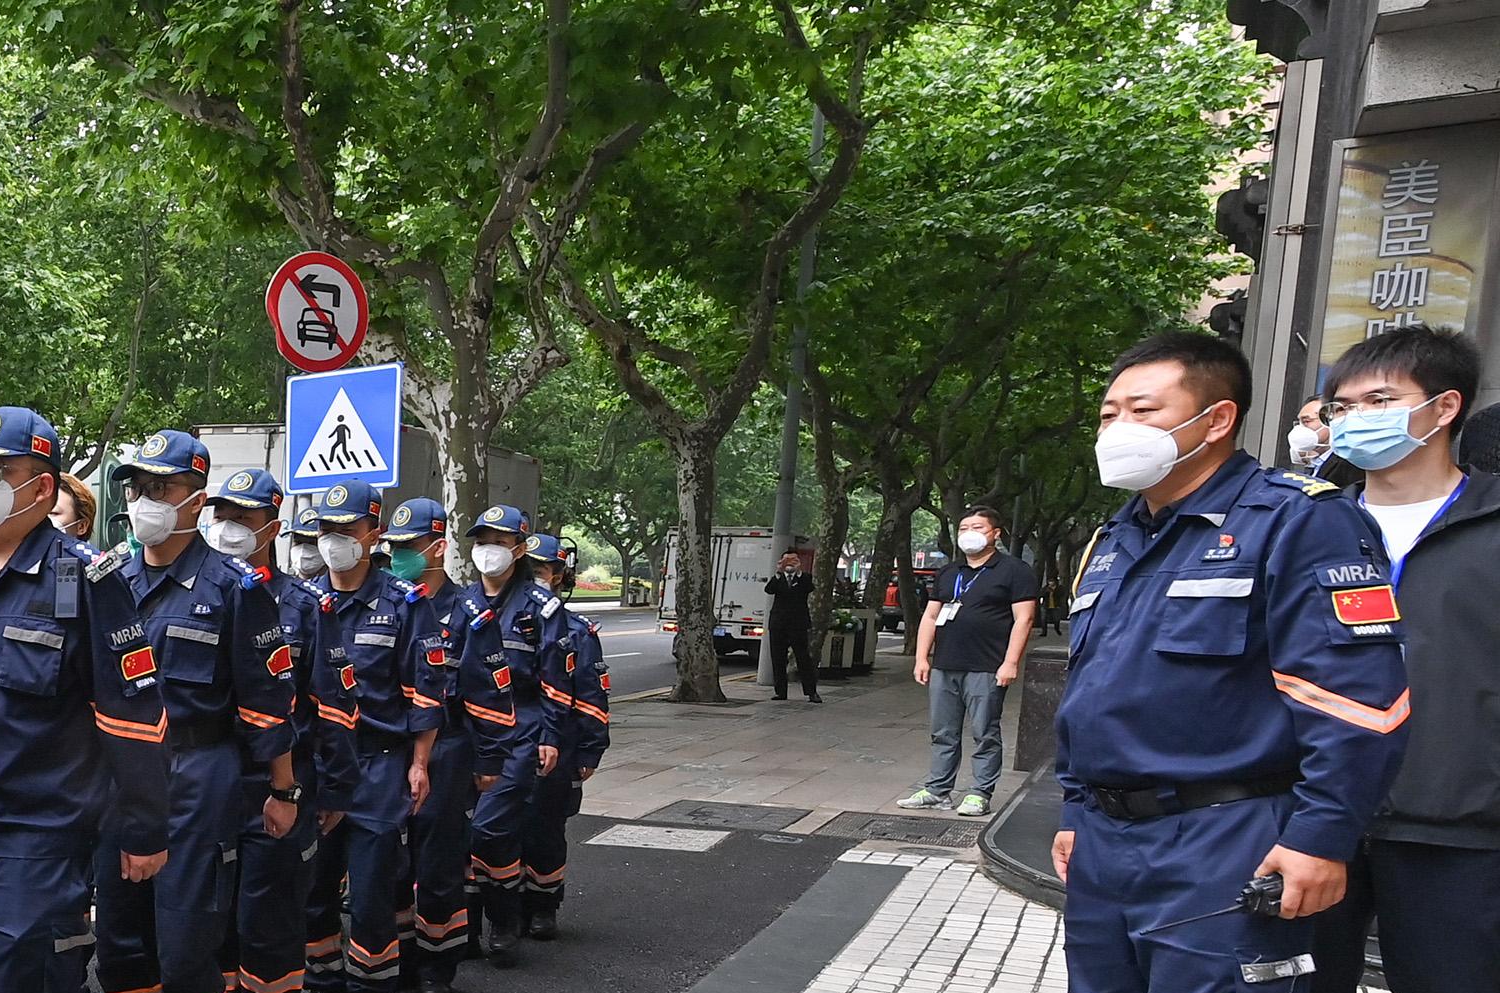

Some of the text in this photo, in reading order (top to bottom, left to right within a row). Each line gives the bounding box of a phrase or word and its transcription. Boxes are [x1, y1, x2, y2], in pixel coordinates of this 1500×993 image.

[1327, 564, 1381, 584] MRA
[110, 623, 145, 646] MRAR
[1353, 624, 1392, 635] 000001
